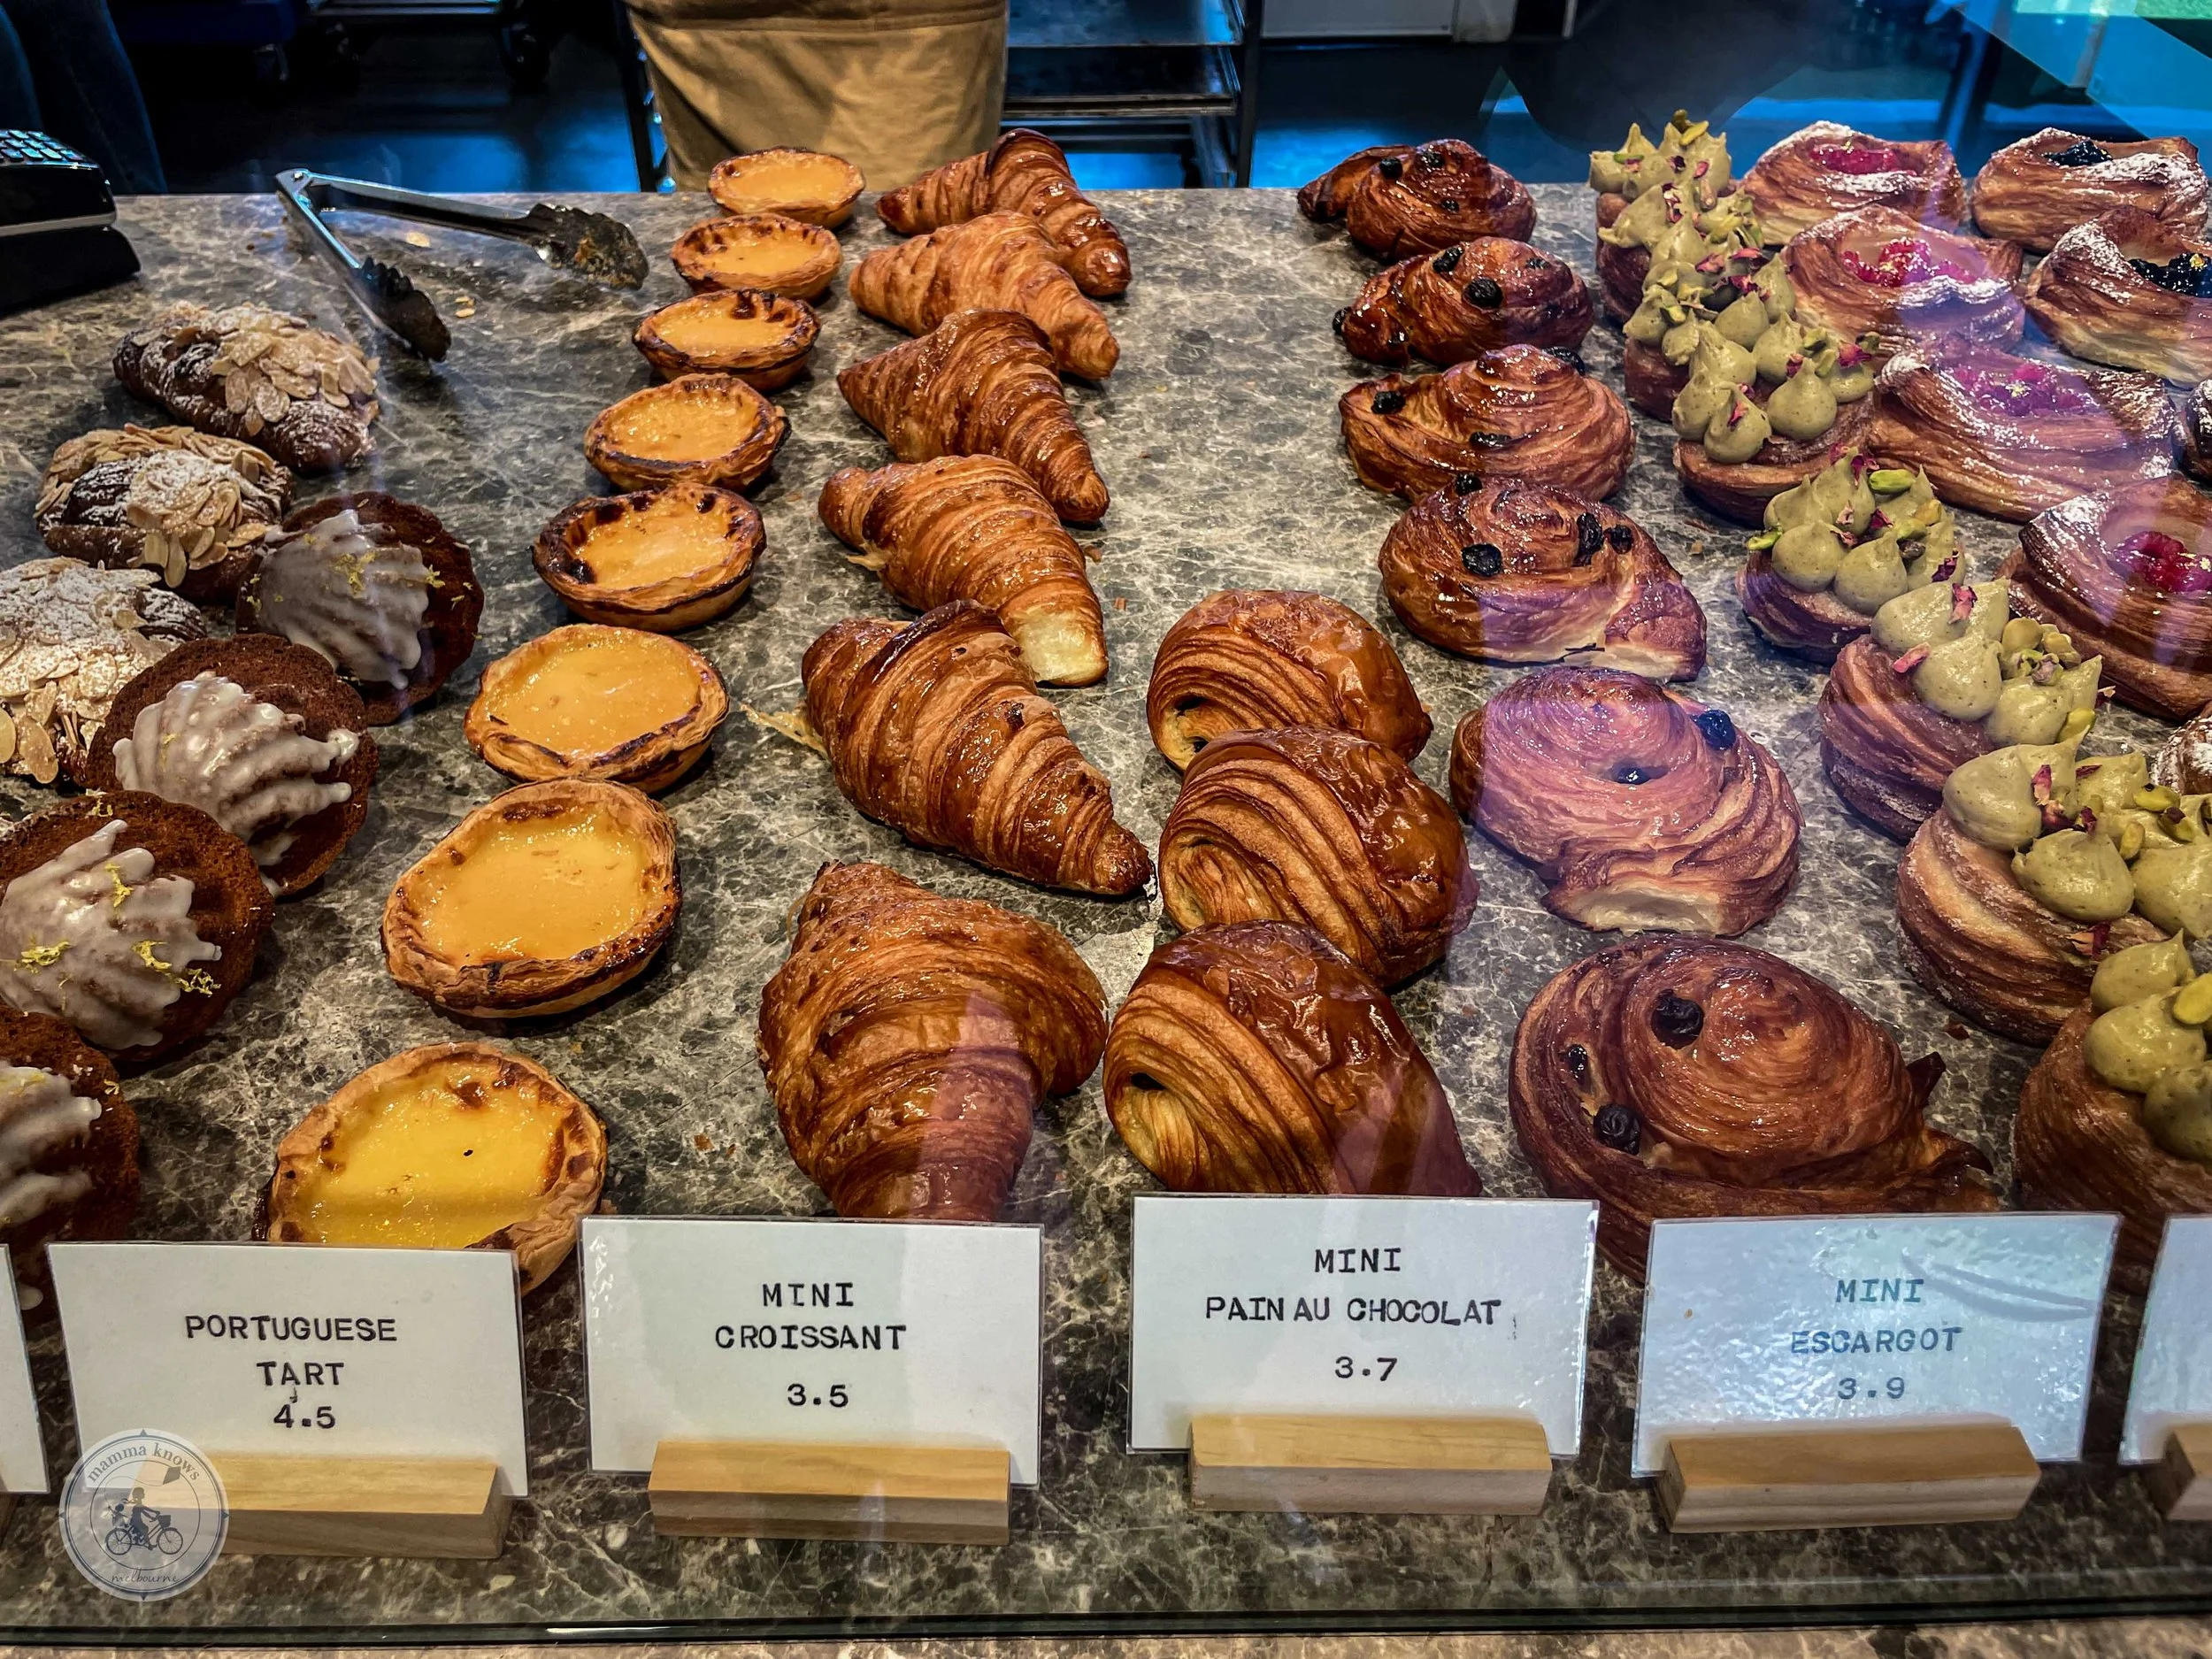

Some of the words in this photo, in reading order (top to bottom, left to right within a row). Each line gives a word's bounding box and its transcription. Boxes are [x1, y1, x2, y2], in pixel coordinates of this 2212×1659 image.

[1314, 1248, 1402, 1273] MINI
[762, 1282, 854, 1308] MINI
[1835, 1279, 1925, 1304] MINI
[1205, 1296, 1285, 1322] PAIN
[1293, 1297, 1331, 1322] AU
[1347, 1298, 1502, 1326] CHOCOLAT
[185, 1315, 398, 1342] PORTUGUESE
[714, 1325, 907, 1351] CROISSANT
[1791, 1326, 1964, 1355] ESCARGOT
[257, 1361, 345, 1387] TART
[1334, 1356, 1399, 1382] 3.7
[787, 1383, 849, 1409] 3.5
[1837, 1376, 1906, 1401] 3.9
[273, 1404, 337, 1430] 4.5
